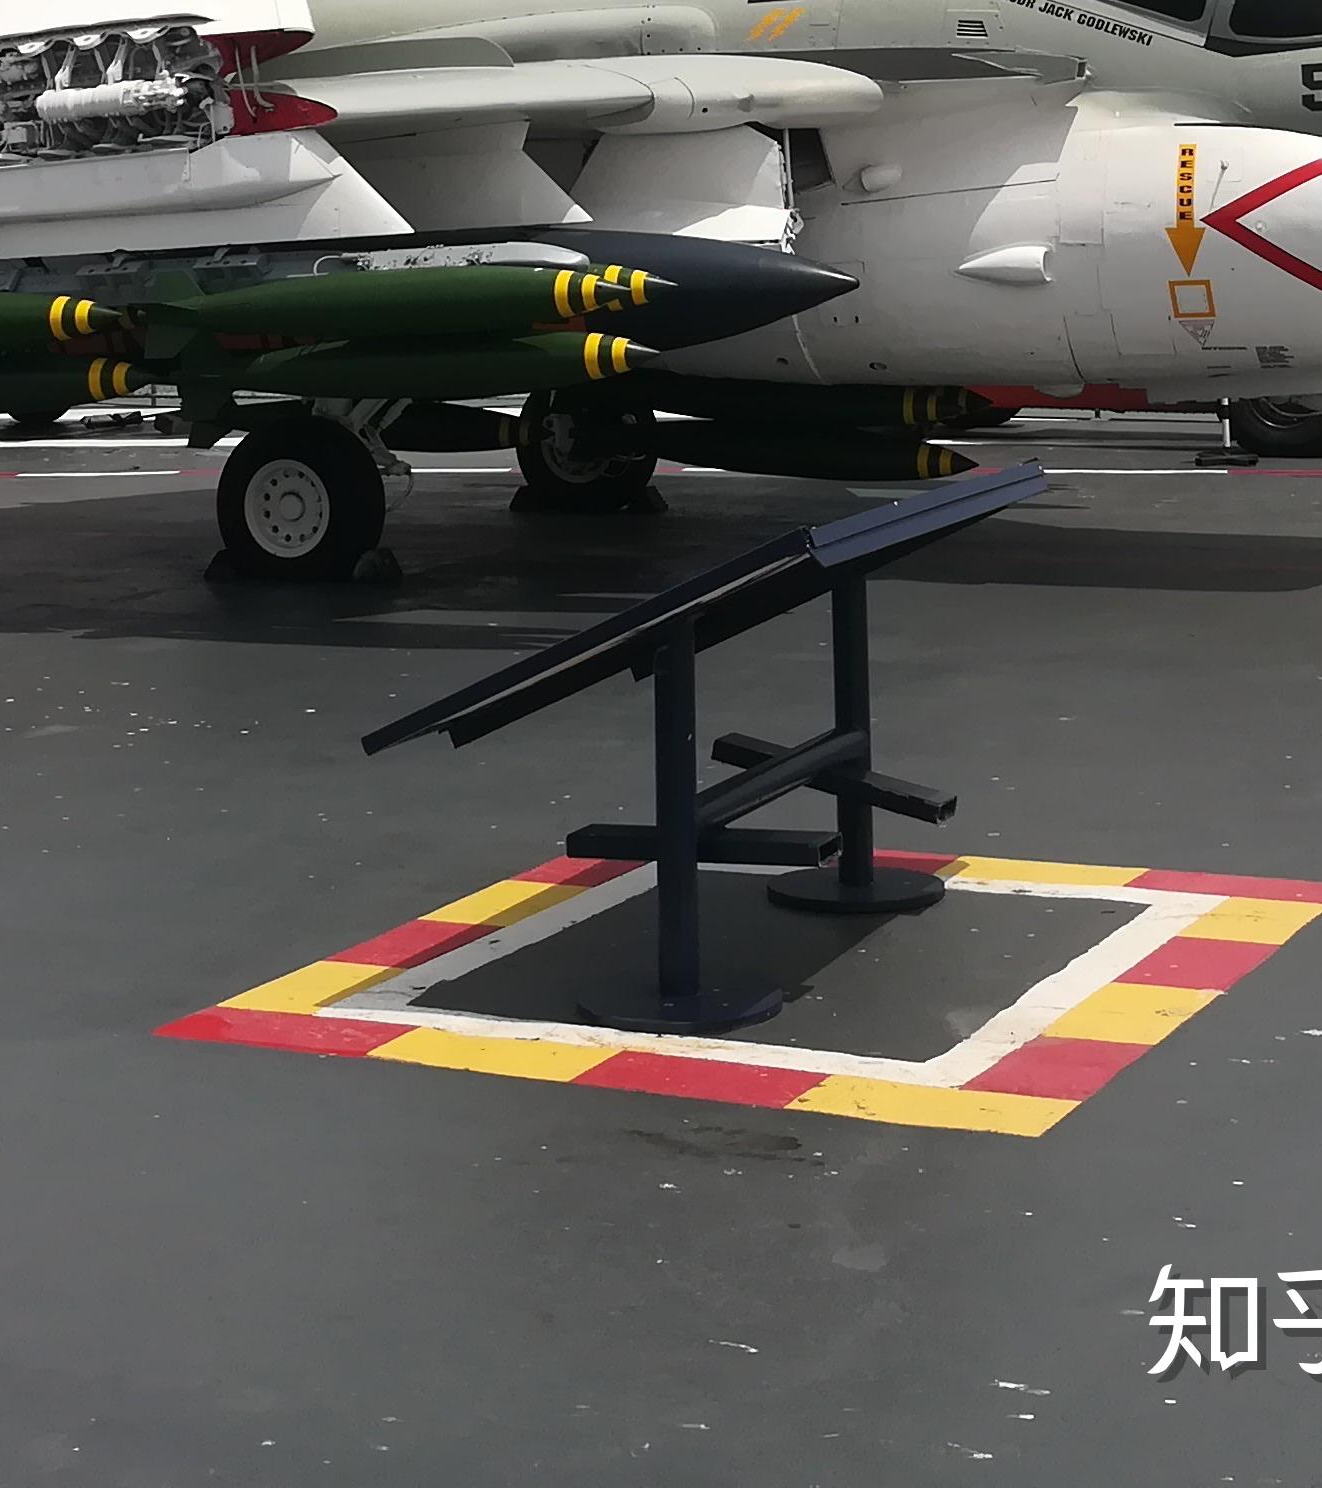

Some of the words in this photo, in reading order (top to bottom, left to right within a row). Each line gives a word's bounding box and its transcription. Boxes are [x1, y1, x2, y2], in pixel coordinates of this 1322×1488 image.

[1038, 2, 1076, 21] JACK
[1077, 13, 1153, 46] GODLEWSKI
[1179, 148, 1194, 220] RESCUE
